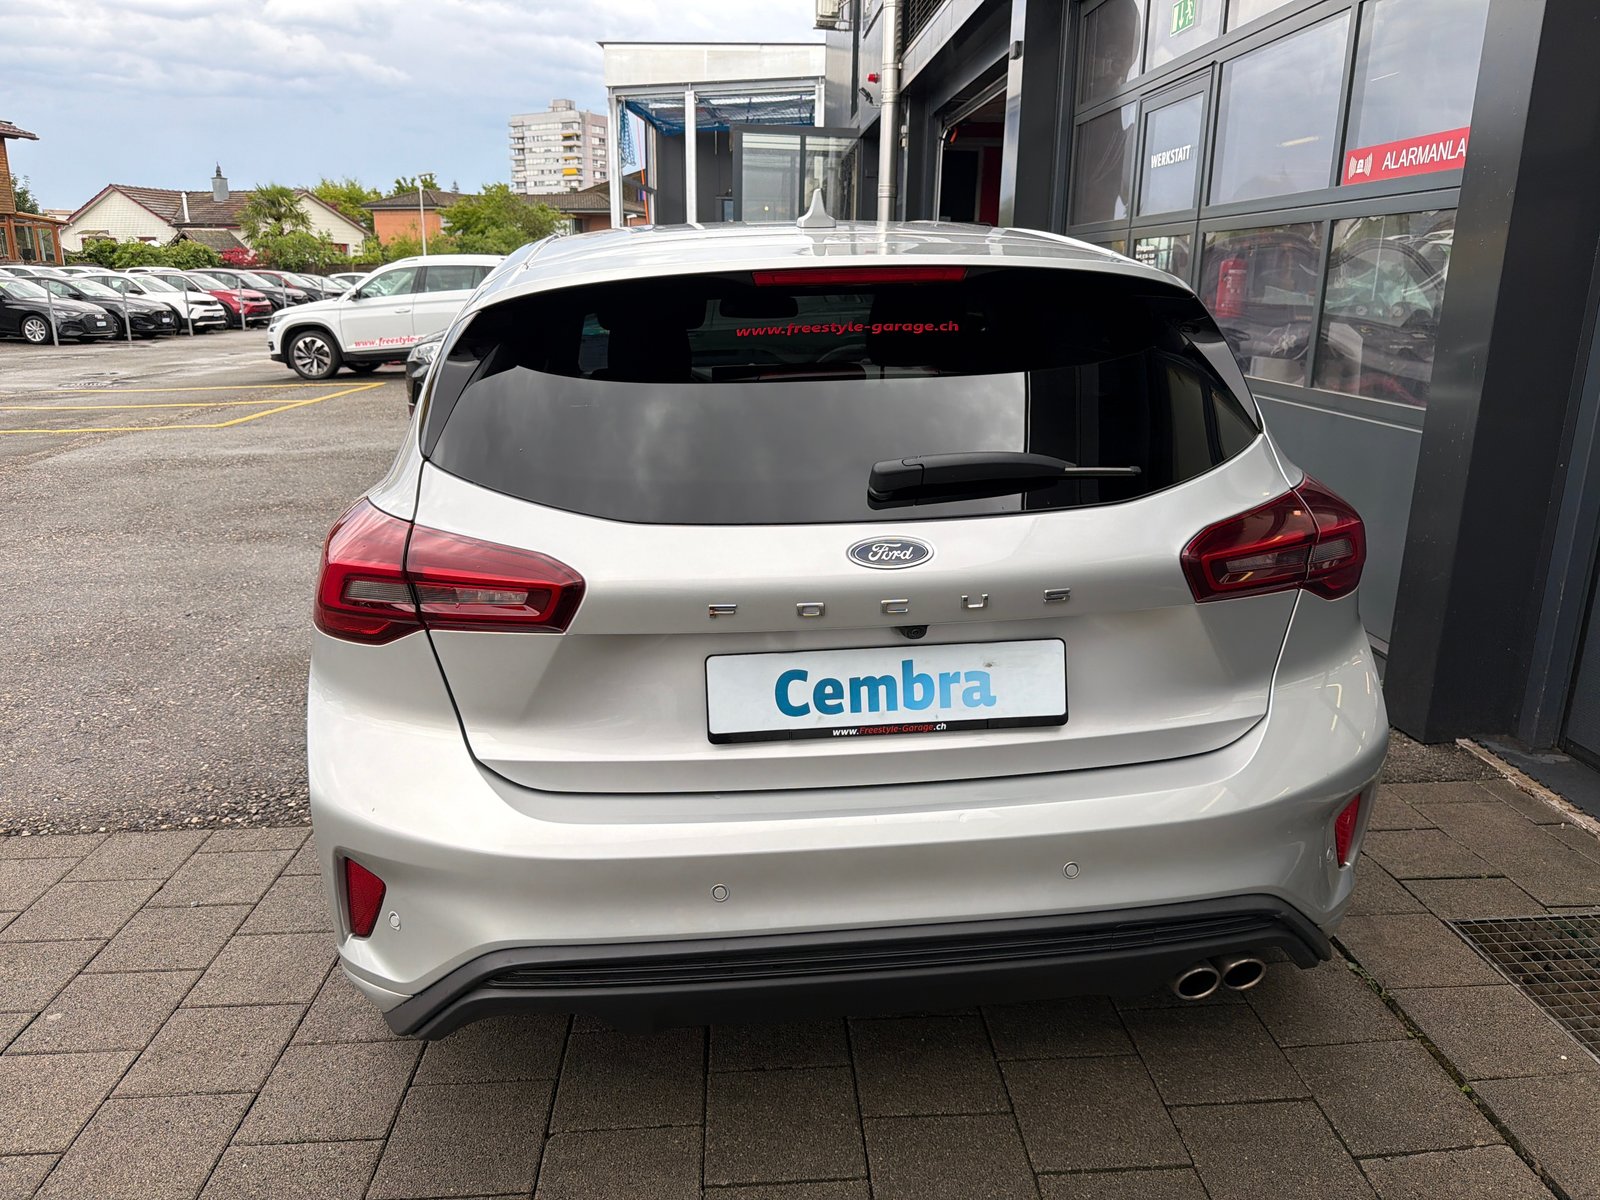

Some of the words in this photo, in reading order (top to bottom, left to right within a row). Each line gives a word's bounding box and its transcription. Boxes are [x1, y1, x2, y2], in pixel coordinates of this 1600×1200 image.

[1151, 144, 1191, 168] WERKSTATT
[1381, 137, 1466, 171] ALARMANLA
[736, 321, 959, 337] www.freestyle-garage.ch
[868, 543, 914, 561] Ford
[708, 588, 1071, 618] FOCUS
[774, 659, 997, 717] Cembra
[832, 723, 947, 736] www.Freestyle-Garage.ch
